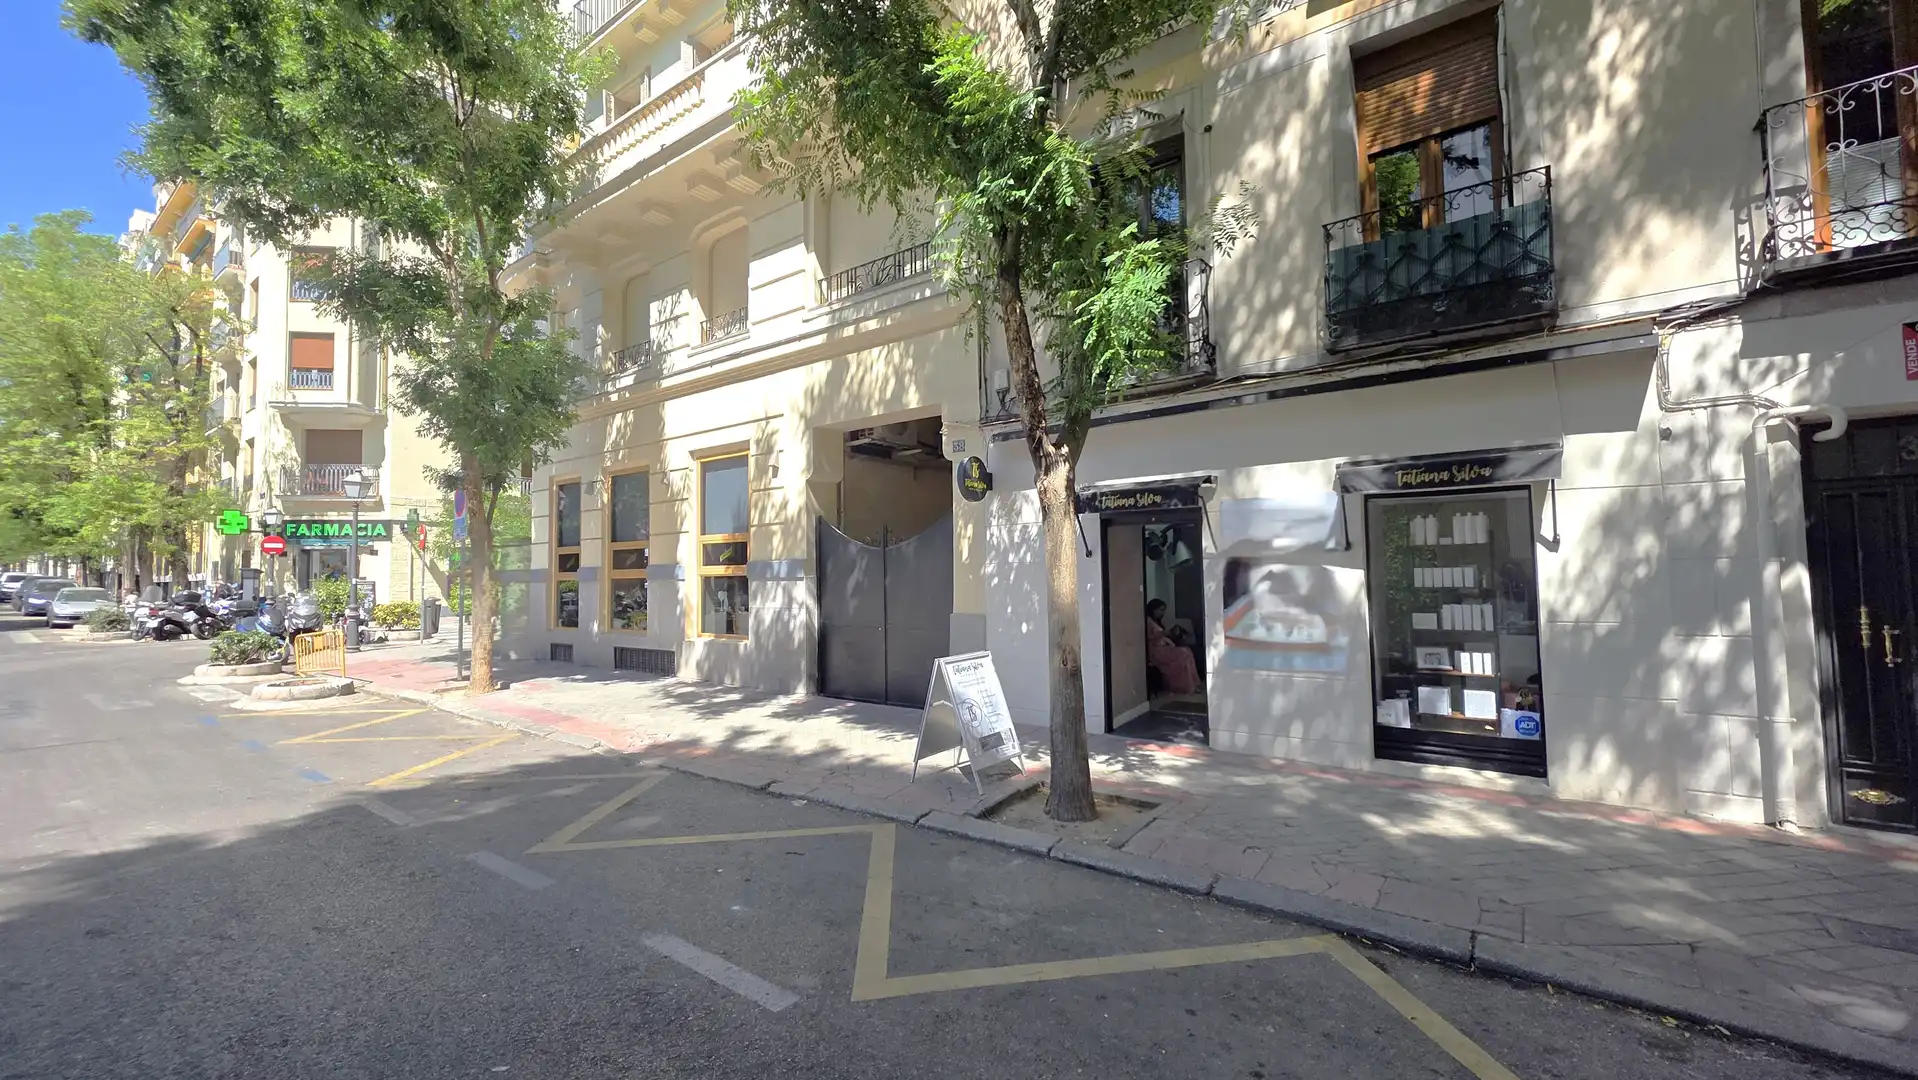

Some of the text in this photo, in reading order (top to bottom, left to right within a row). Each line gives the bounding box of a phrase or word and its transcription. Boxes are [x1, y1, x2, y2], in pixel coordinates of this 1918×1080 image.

[1905, 338, 1918, 374] VENDE
[1395, 464, 1493, 487] Tatiana Silva
[1136, 492, 1162, 507] Silva
[286, 523, 387, 536] FARMACIA
[1519, 720, 1536, 729] ADT
